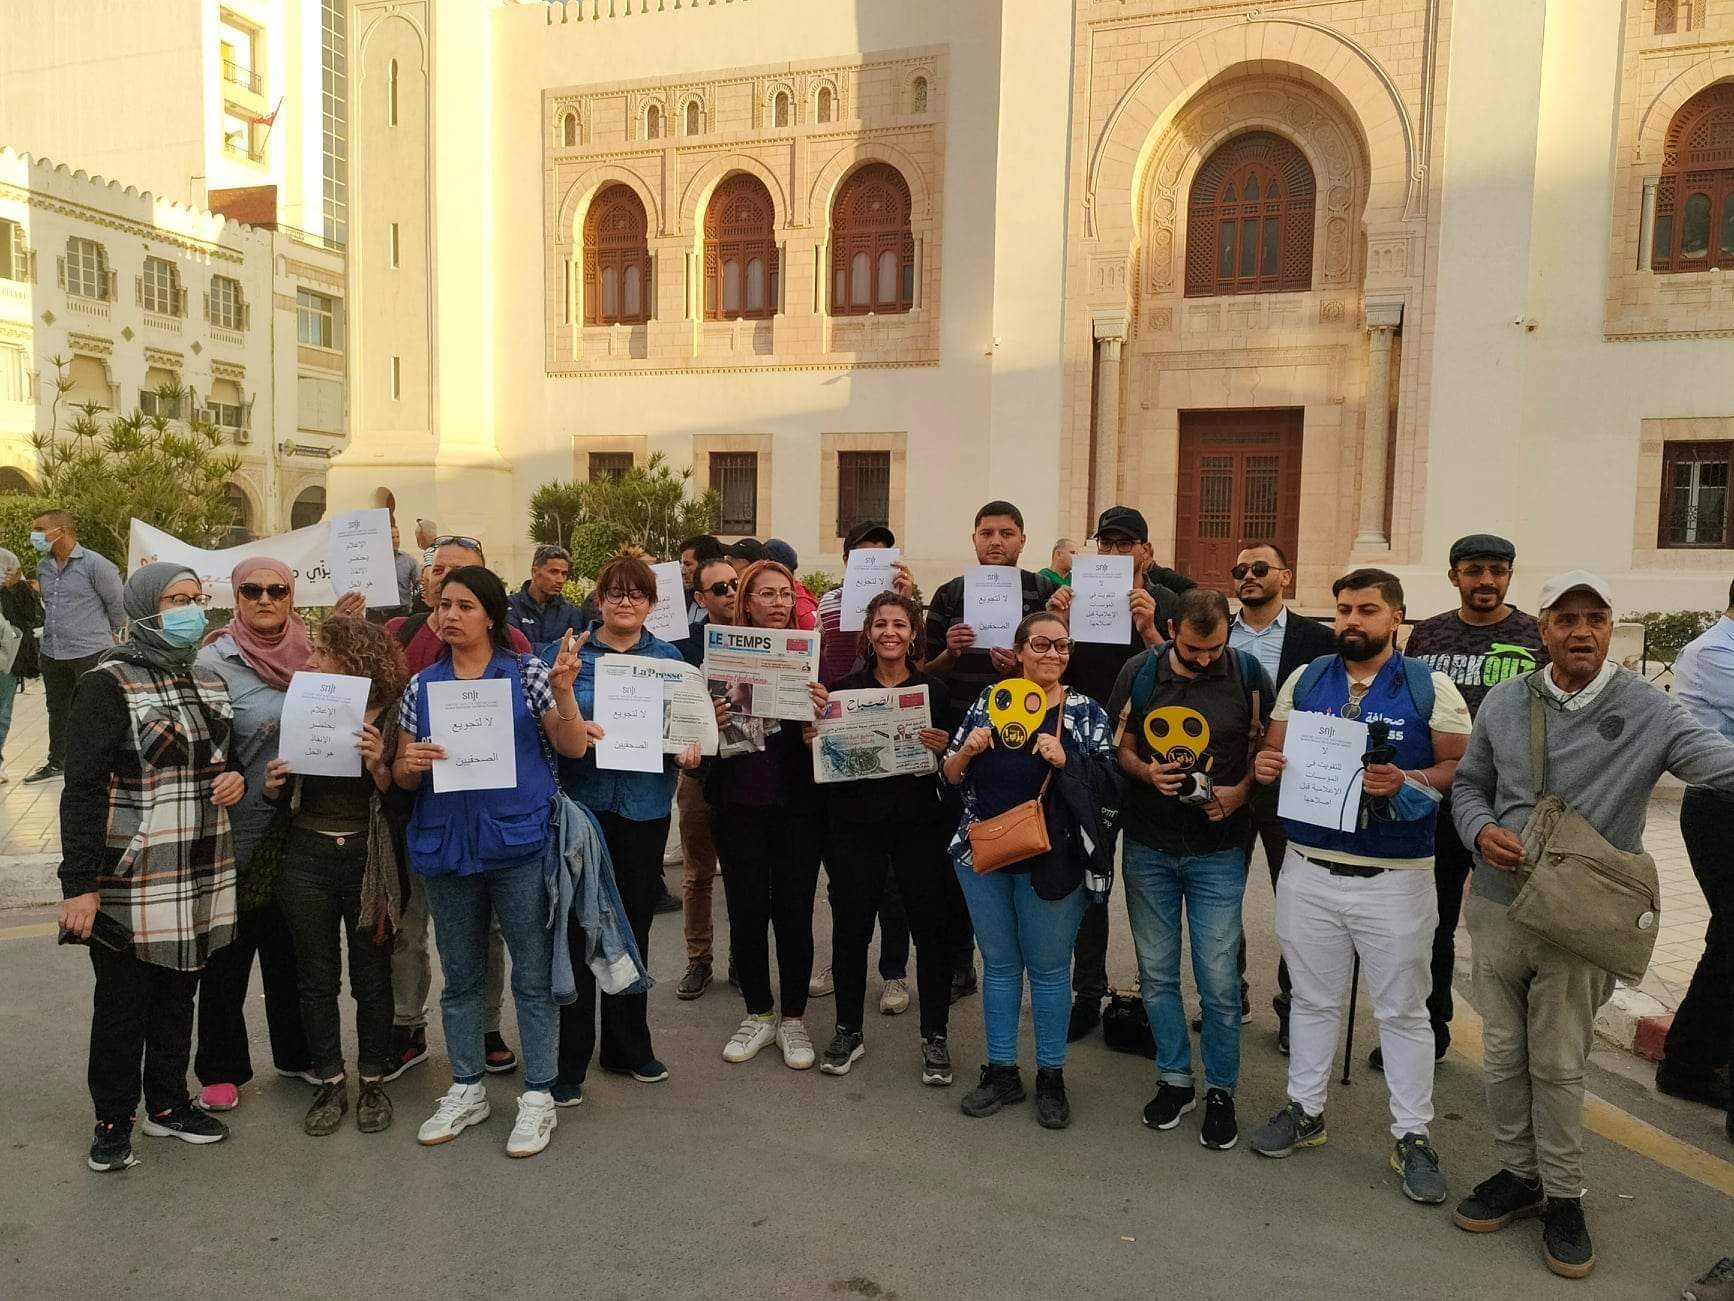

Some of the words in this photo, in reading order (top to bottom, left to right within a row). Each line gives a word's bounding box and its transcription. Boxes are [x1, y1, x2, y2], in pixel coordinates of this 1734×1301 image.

[709, 631, 723, 646] LE
[728, 634, 771, 650] TEMPS
[1365, 711, 1405, 726] صحافة
